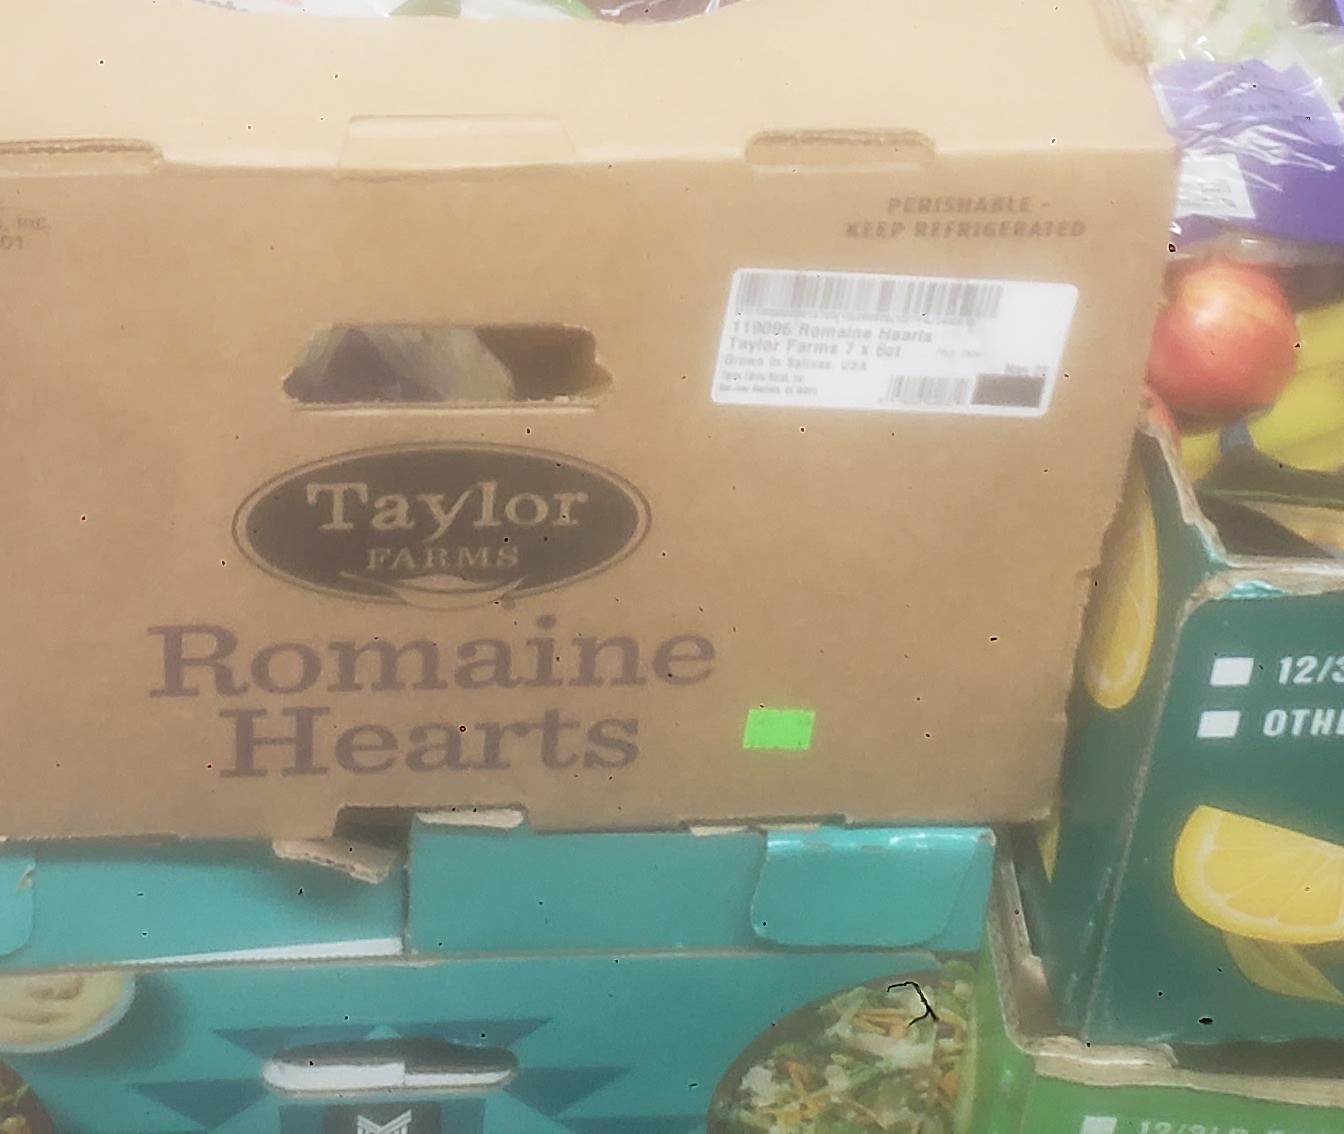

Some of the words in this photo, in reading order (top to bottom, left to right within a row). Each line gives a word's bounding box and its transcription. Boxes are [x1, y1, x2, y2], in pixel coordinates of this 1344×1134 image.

[887, 196, 1032, 214] PERISHABLE
[845, 222, 906, 239] KEEP
[913, 220, 1087, 239] REFRIGERATED
[798, 323, 872, 340] Romaine
[879, 327, 933, 344] Hearts
[728, 336, 780, 354] Taylor
[786, 338, 838, 355] Farms
[724, 354, 765, 368] Grown
[307, 480, 588, 541] Taylor
[366, 545, 520, 572] FARMS
[147, 614, 717, 698] Romaine
[219, 706, 640, 779] Hearts
